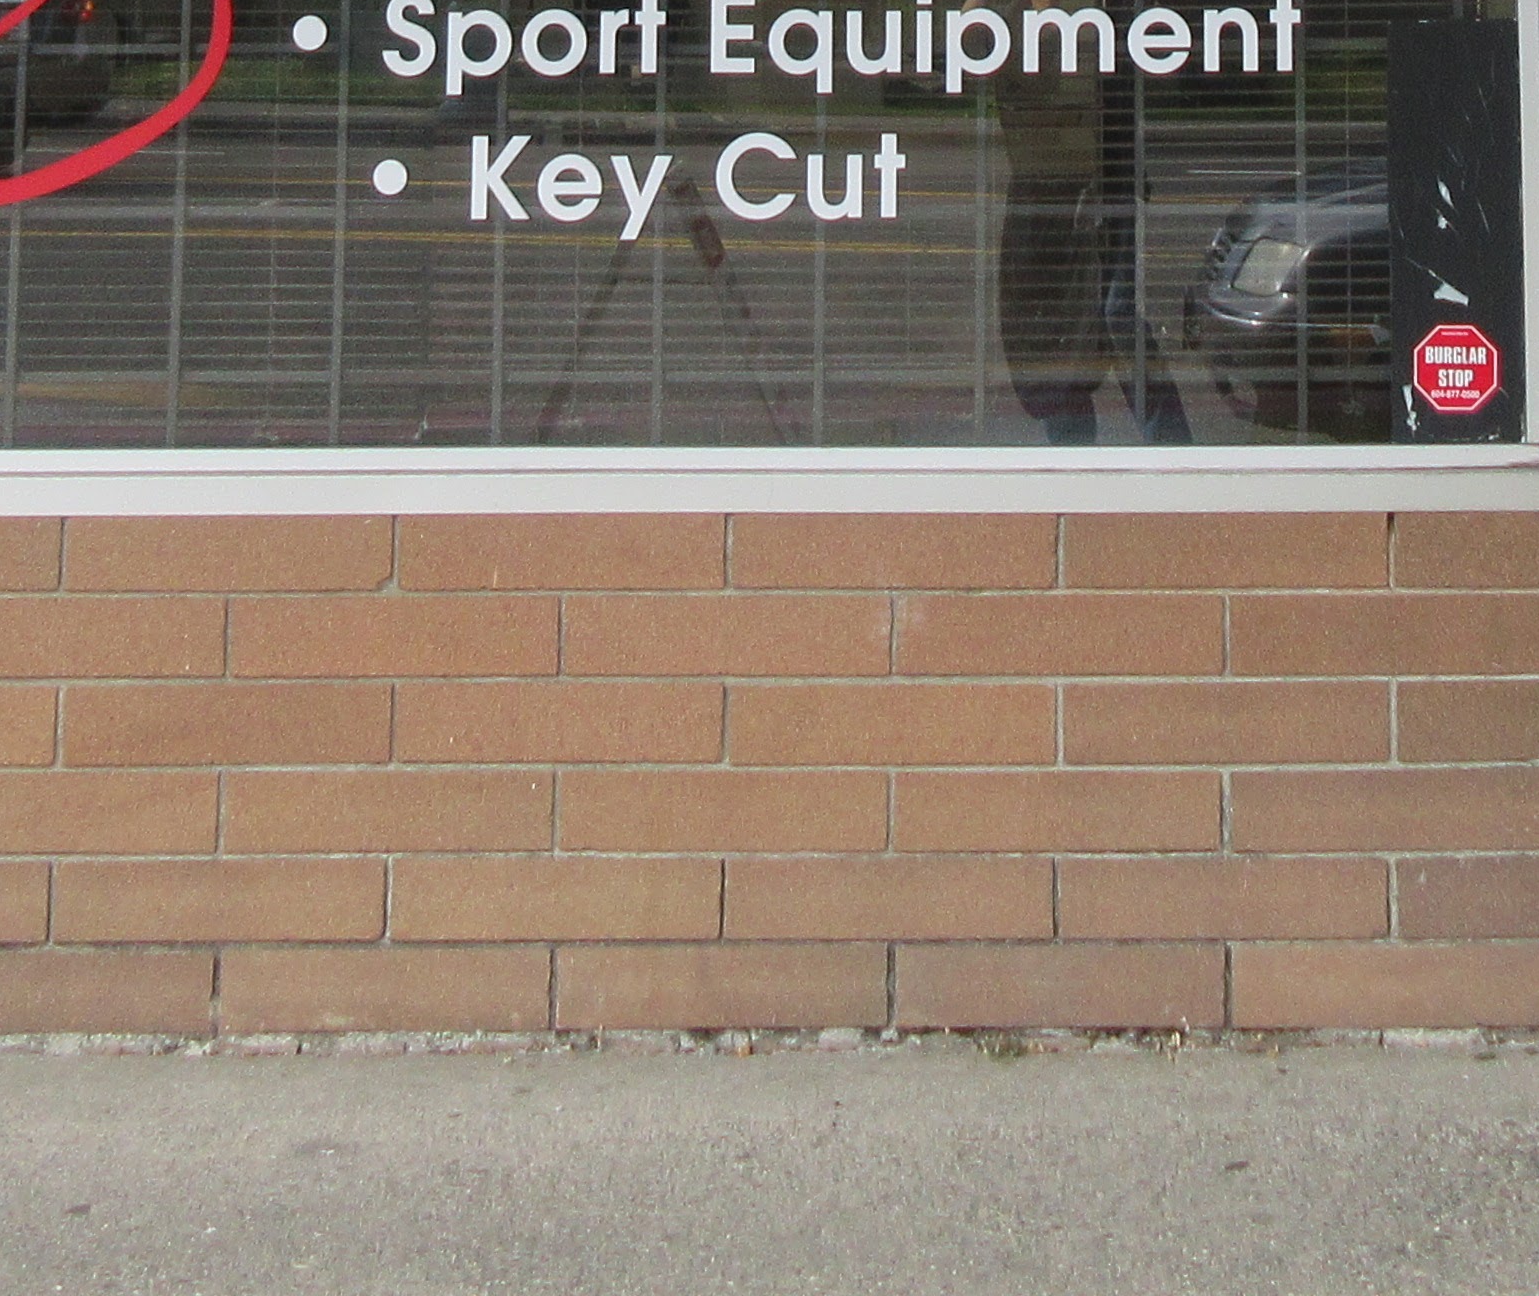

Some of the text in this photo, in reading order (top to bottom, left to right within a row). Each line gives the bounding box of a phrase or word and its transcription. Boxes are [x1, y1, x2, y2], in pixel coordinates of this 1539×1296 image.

[470, 133, 907, 242] Key Cut
[1425, 346, 1487, 365] BURGLAR
[1438, 369, 1473, 387] STOP
